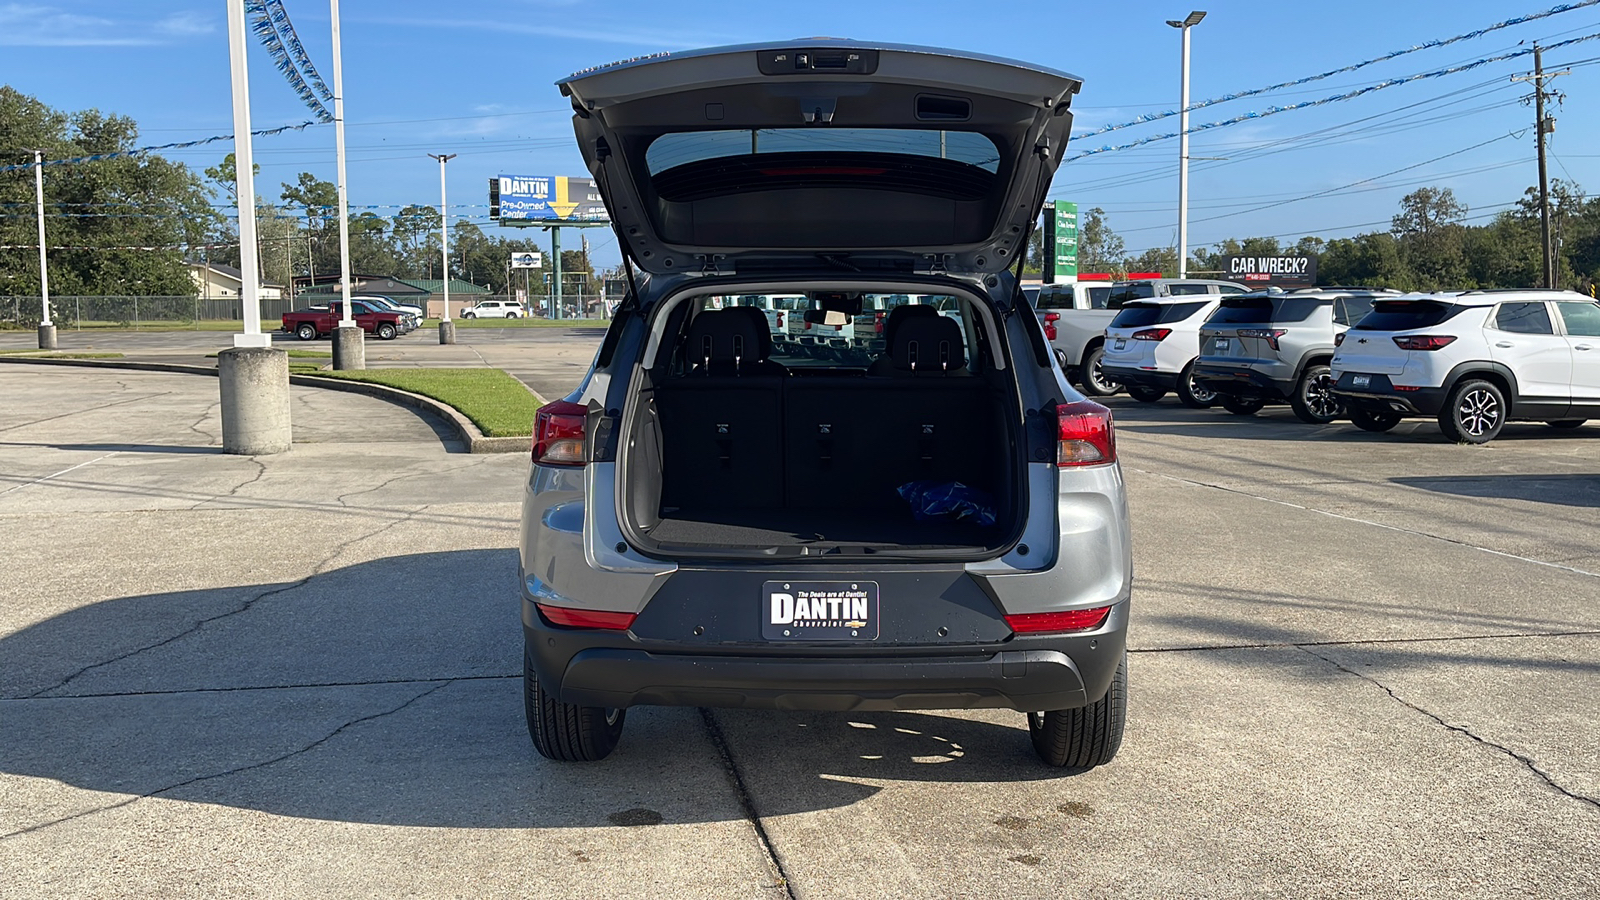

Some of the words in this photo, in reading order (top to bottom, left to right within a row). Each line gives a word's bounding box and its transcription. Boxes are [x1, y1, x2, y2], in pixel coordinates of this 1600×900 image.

[500, 177, 549, 195] DANTIN
[501, 200, 545, 210] Pre-Owned
[501, 209, 528, 218] Center
[1231, 257, 1256, 273] CAR
[1258, 257, 1308, 273] WRECK?
[771, 593, 868, 625] DANTIN
[793, 620, 842, 628] Chevrolet
